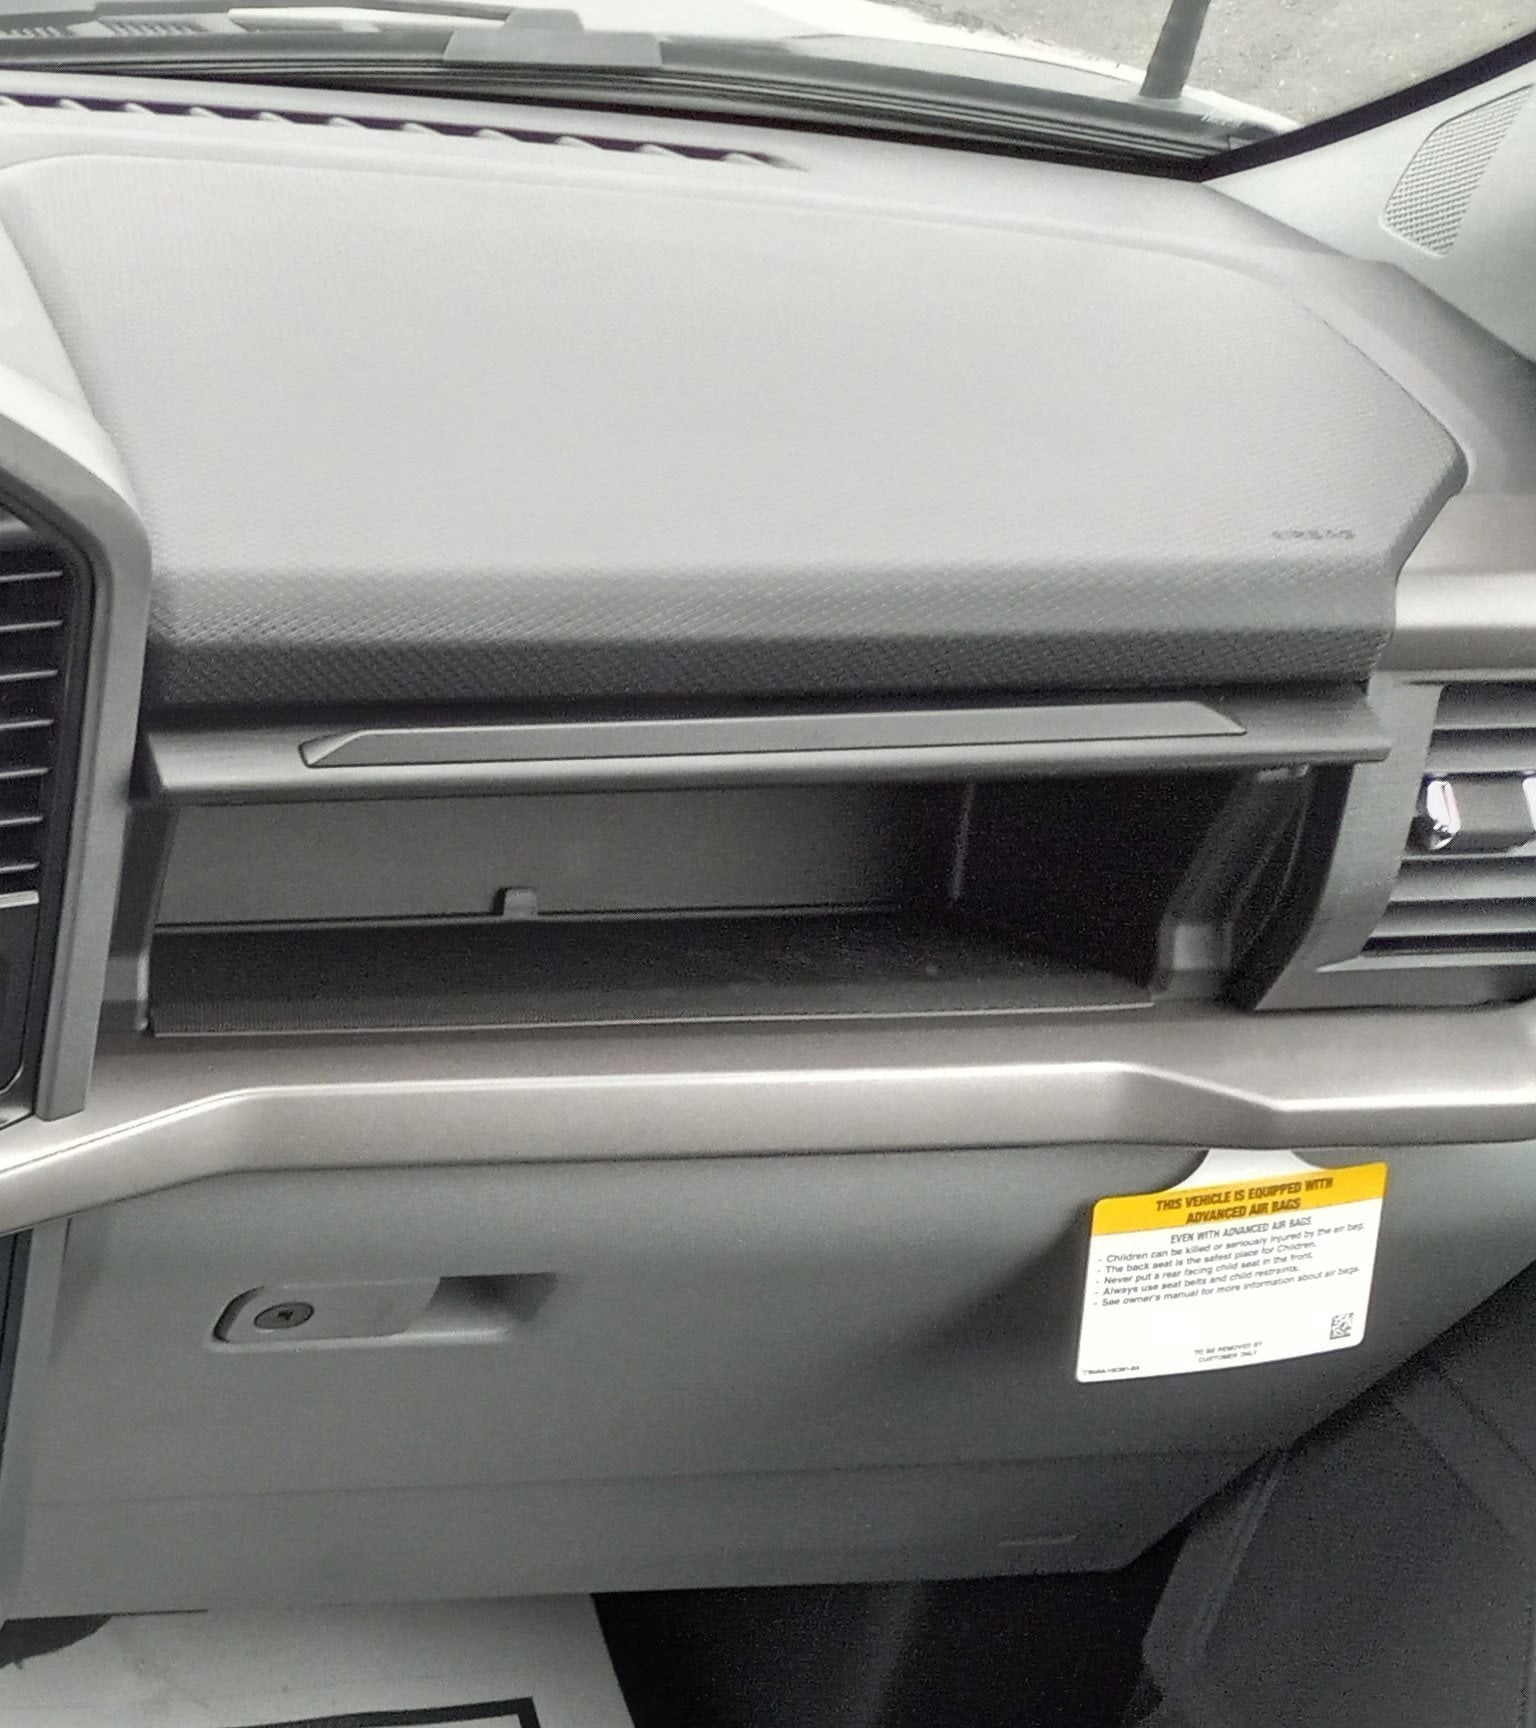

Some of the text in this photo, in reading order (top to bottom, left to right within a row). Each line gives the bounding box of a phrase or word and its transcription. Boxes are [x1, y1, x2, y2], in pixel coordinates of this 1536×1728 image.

[1156, 1178, 1334, 1211] THIS VEHICLE IS EQUIPPED WITH
[1186, 1198, 1301, 1224] ADVANCED AIR BAGS
[1171, 1216, 1312, 1244] EVEN WITH ADVANCED AIR BAGS
[1107, 1252, 1148, 1263] Children
[1186, 1244, 1210, 1254] killed
[1226, 1237, 1267, 1249] seriously
